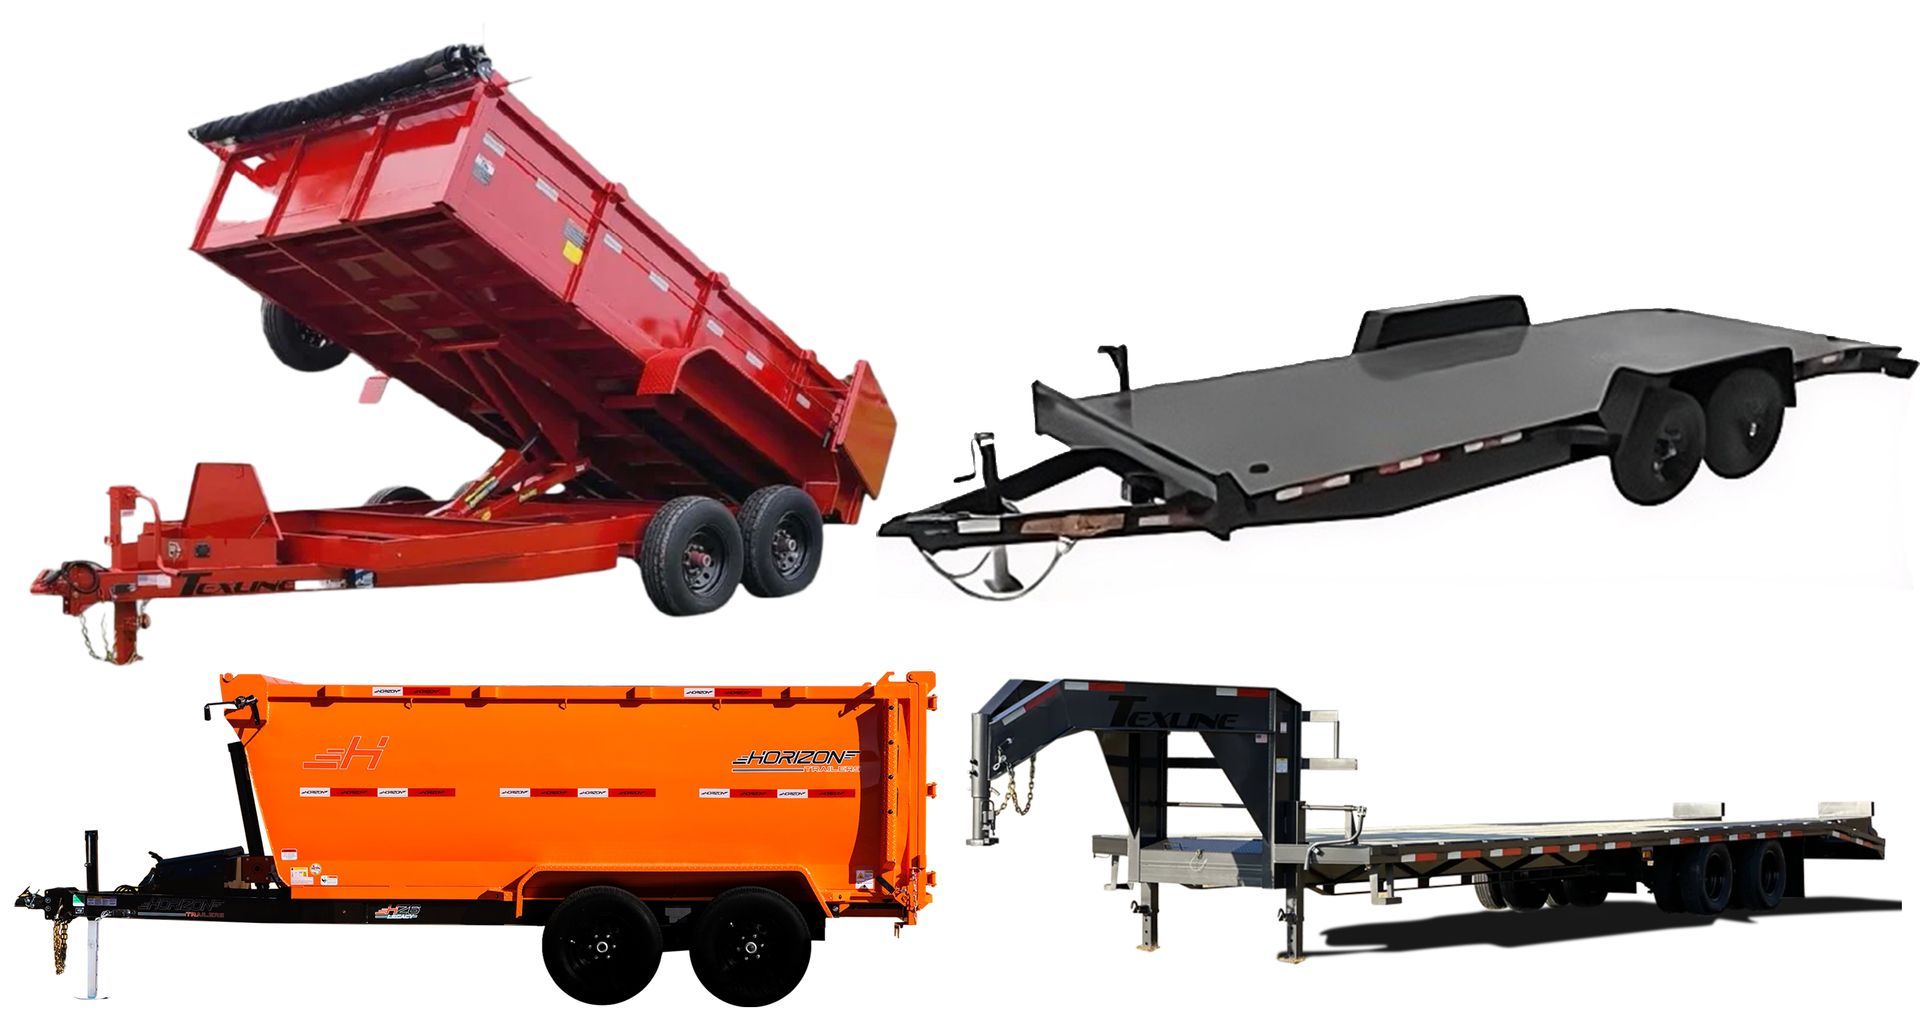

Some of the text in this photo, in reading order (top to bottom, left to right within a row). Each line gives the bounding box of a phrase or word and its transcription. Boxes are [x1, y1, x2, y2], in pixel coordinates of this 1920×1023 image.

[177, 571, 295, 597] TEXLINE
[1108, 695, 1240, 730] TEXLINE
[744, 750, 850, 765] HORIZON
[803, 765, 861, 773] TRAILERS
